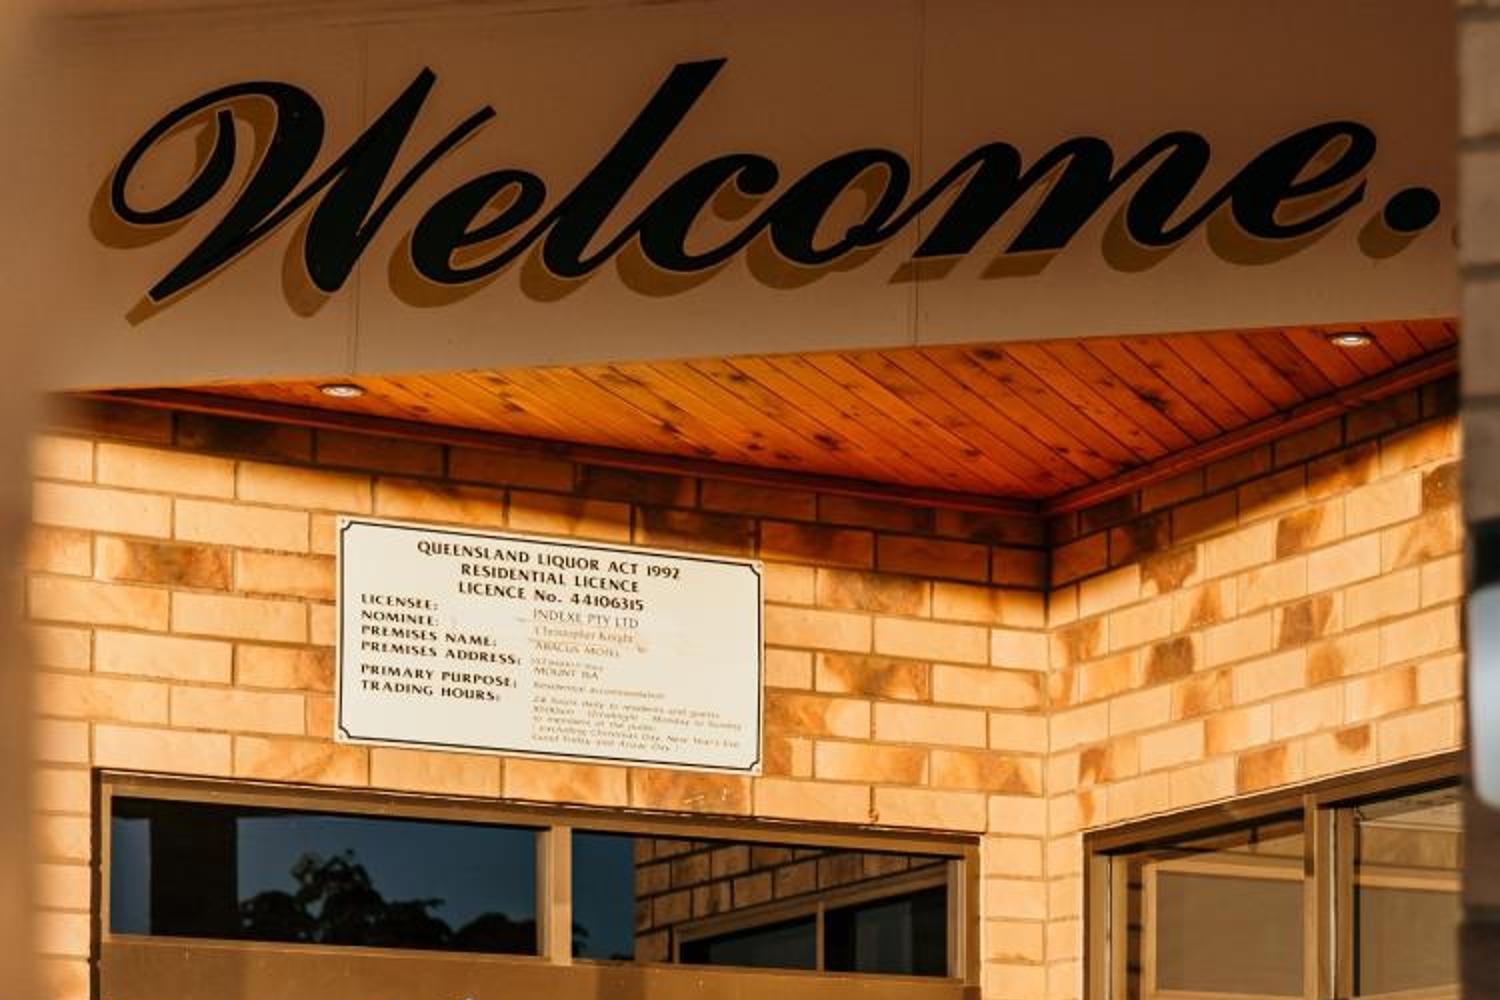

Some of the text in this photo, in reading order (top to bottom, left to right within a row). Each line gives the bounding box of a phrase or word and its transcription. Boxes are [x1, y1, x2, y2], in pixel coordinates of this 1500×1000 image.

[106, 56, 1442, 308] Welcome.
[416, 540, 680, 579] QUEENSLAND LIQUOR ACT 1992
[461, 563, 639, 593] RESIDENTIAL LICENCE
[459, 581, 644, 611] LICENCE No. 44106315
[361, 593, 439, 610] LICENSEE:
[587, 611, 610, 627] PTY
[615, 615, 639, 629] LTD
[361, 610, 439, 626] NOMINEE:
[361, 625, 438, 641] PREMISES
[445, 633, 497, 647] NAME:
[361, 640, 438, 657] PREMISES
[445, 649, 521, 665] ADDRESS:
[361, 664, 435, 680] PRIMARY
[441, 671, 518, 688] PURPOSE:
[361, 679, 434, 696] TRADING
[441, 688, 501, 702] HOURS:
